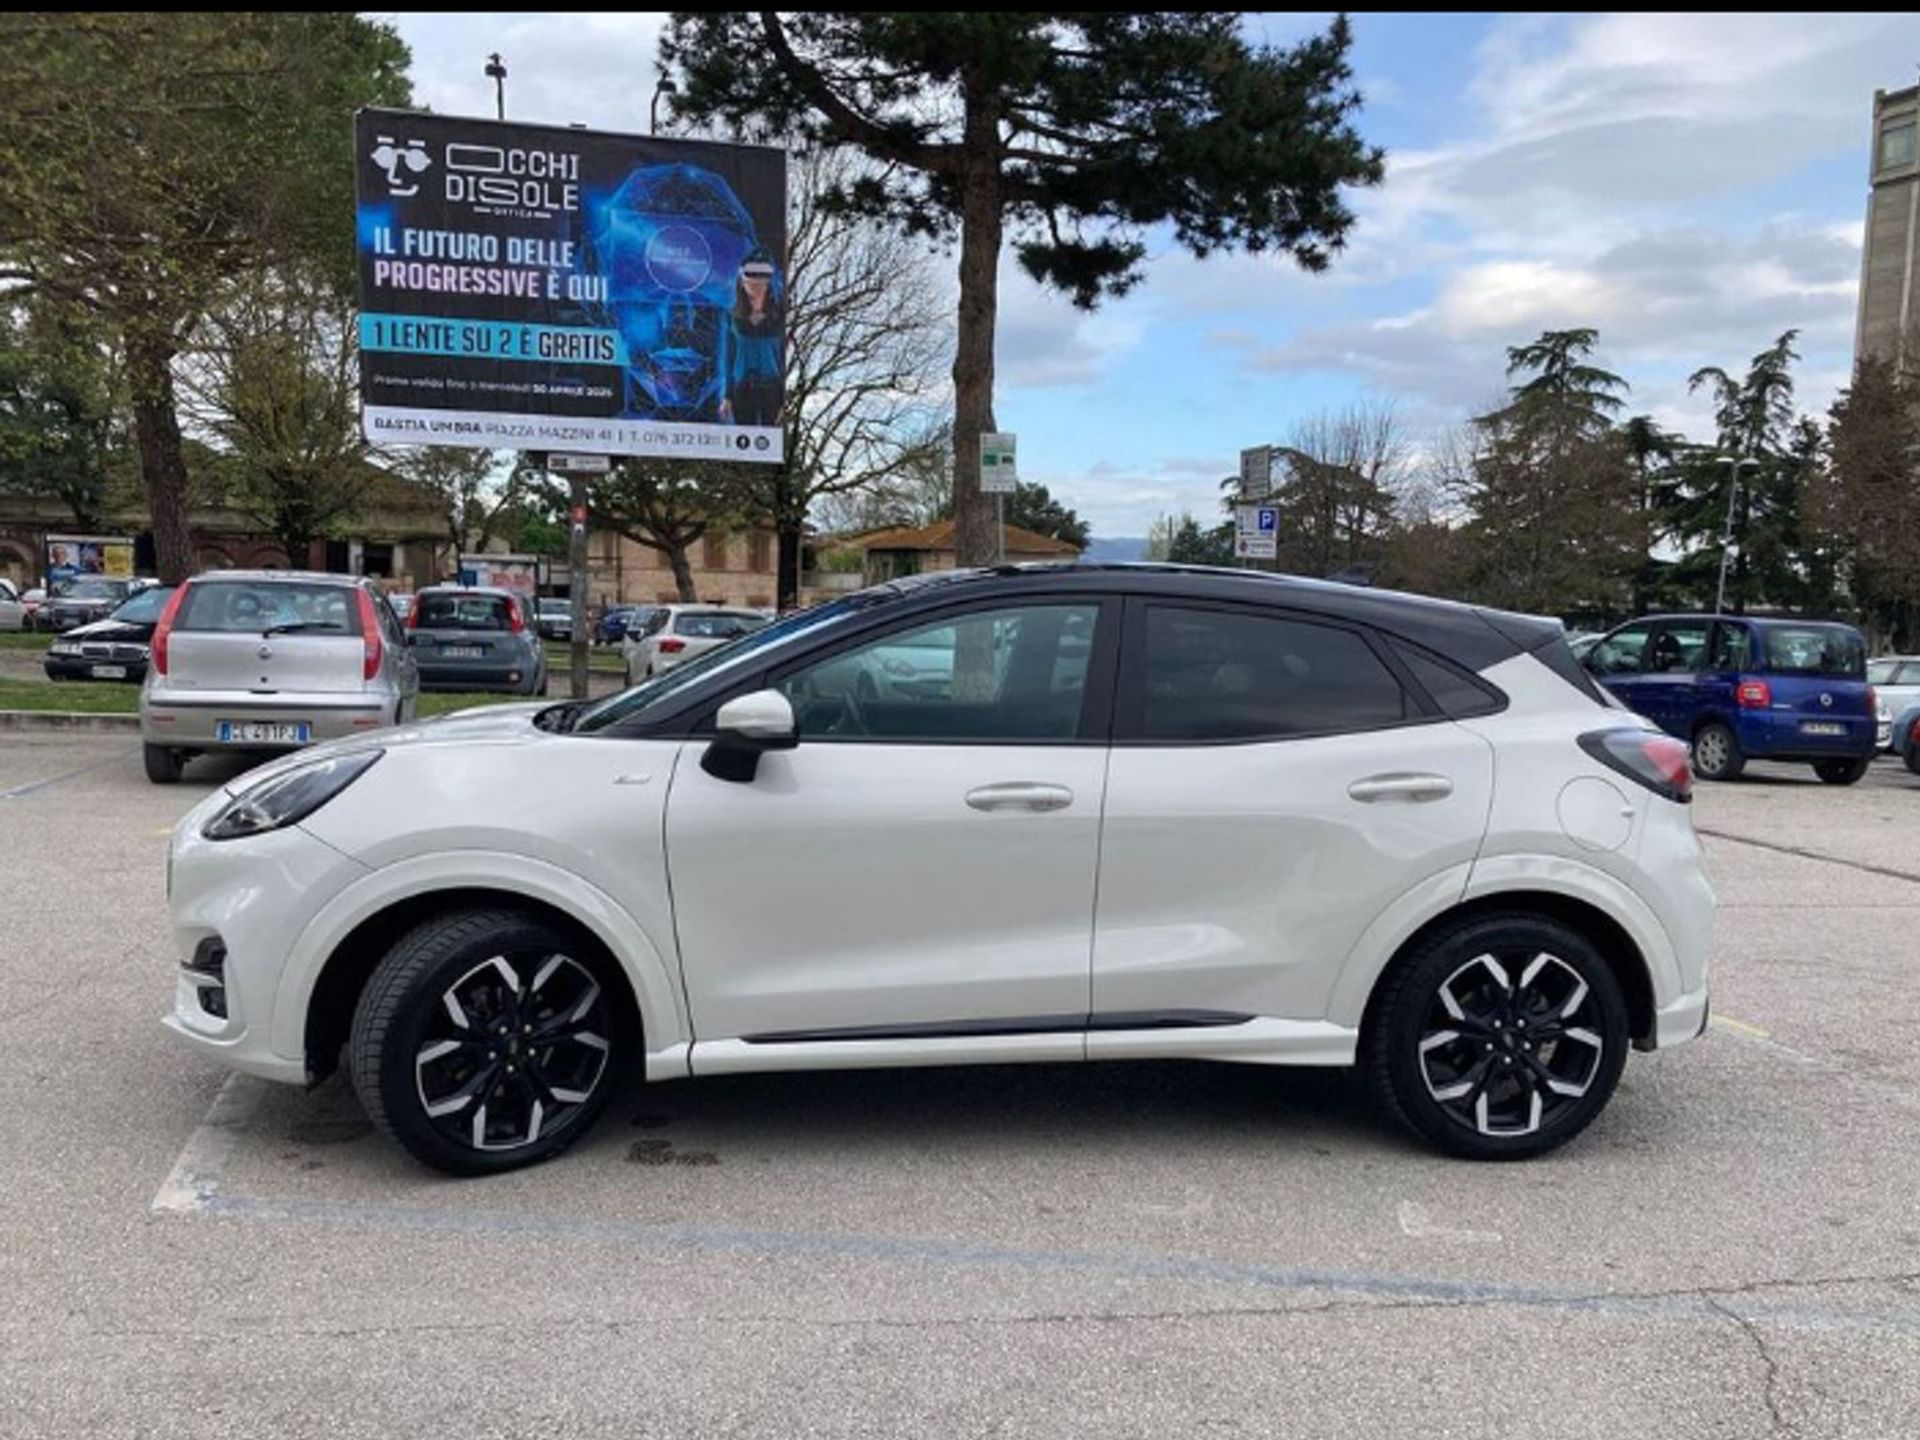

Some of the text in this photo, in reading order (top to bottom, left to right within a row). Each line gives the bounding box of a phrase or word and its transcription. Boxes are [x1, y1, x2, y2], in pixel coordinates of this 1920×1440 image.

[445, 143, 580, 181] OCCHI
[374, 226, 575, 268] IL FUTURO DELLE
[374, 260, 608, 302] PROGRESSIVE È QUI
[374, 320, 615, 361] 1 LENTE SU 2 È GRATIS
[374, 417, 427, 432] BASTIA
[430, 420, 482, 434] UMBRA
[485, 422, 535, 437] PIAZZA
